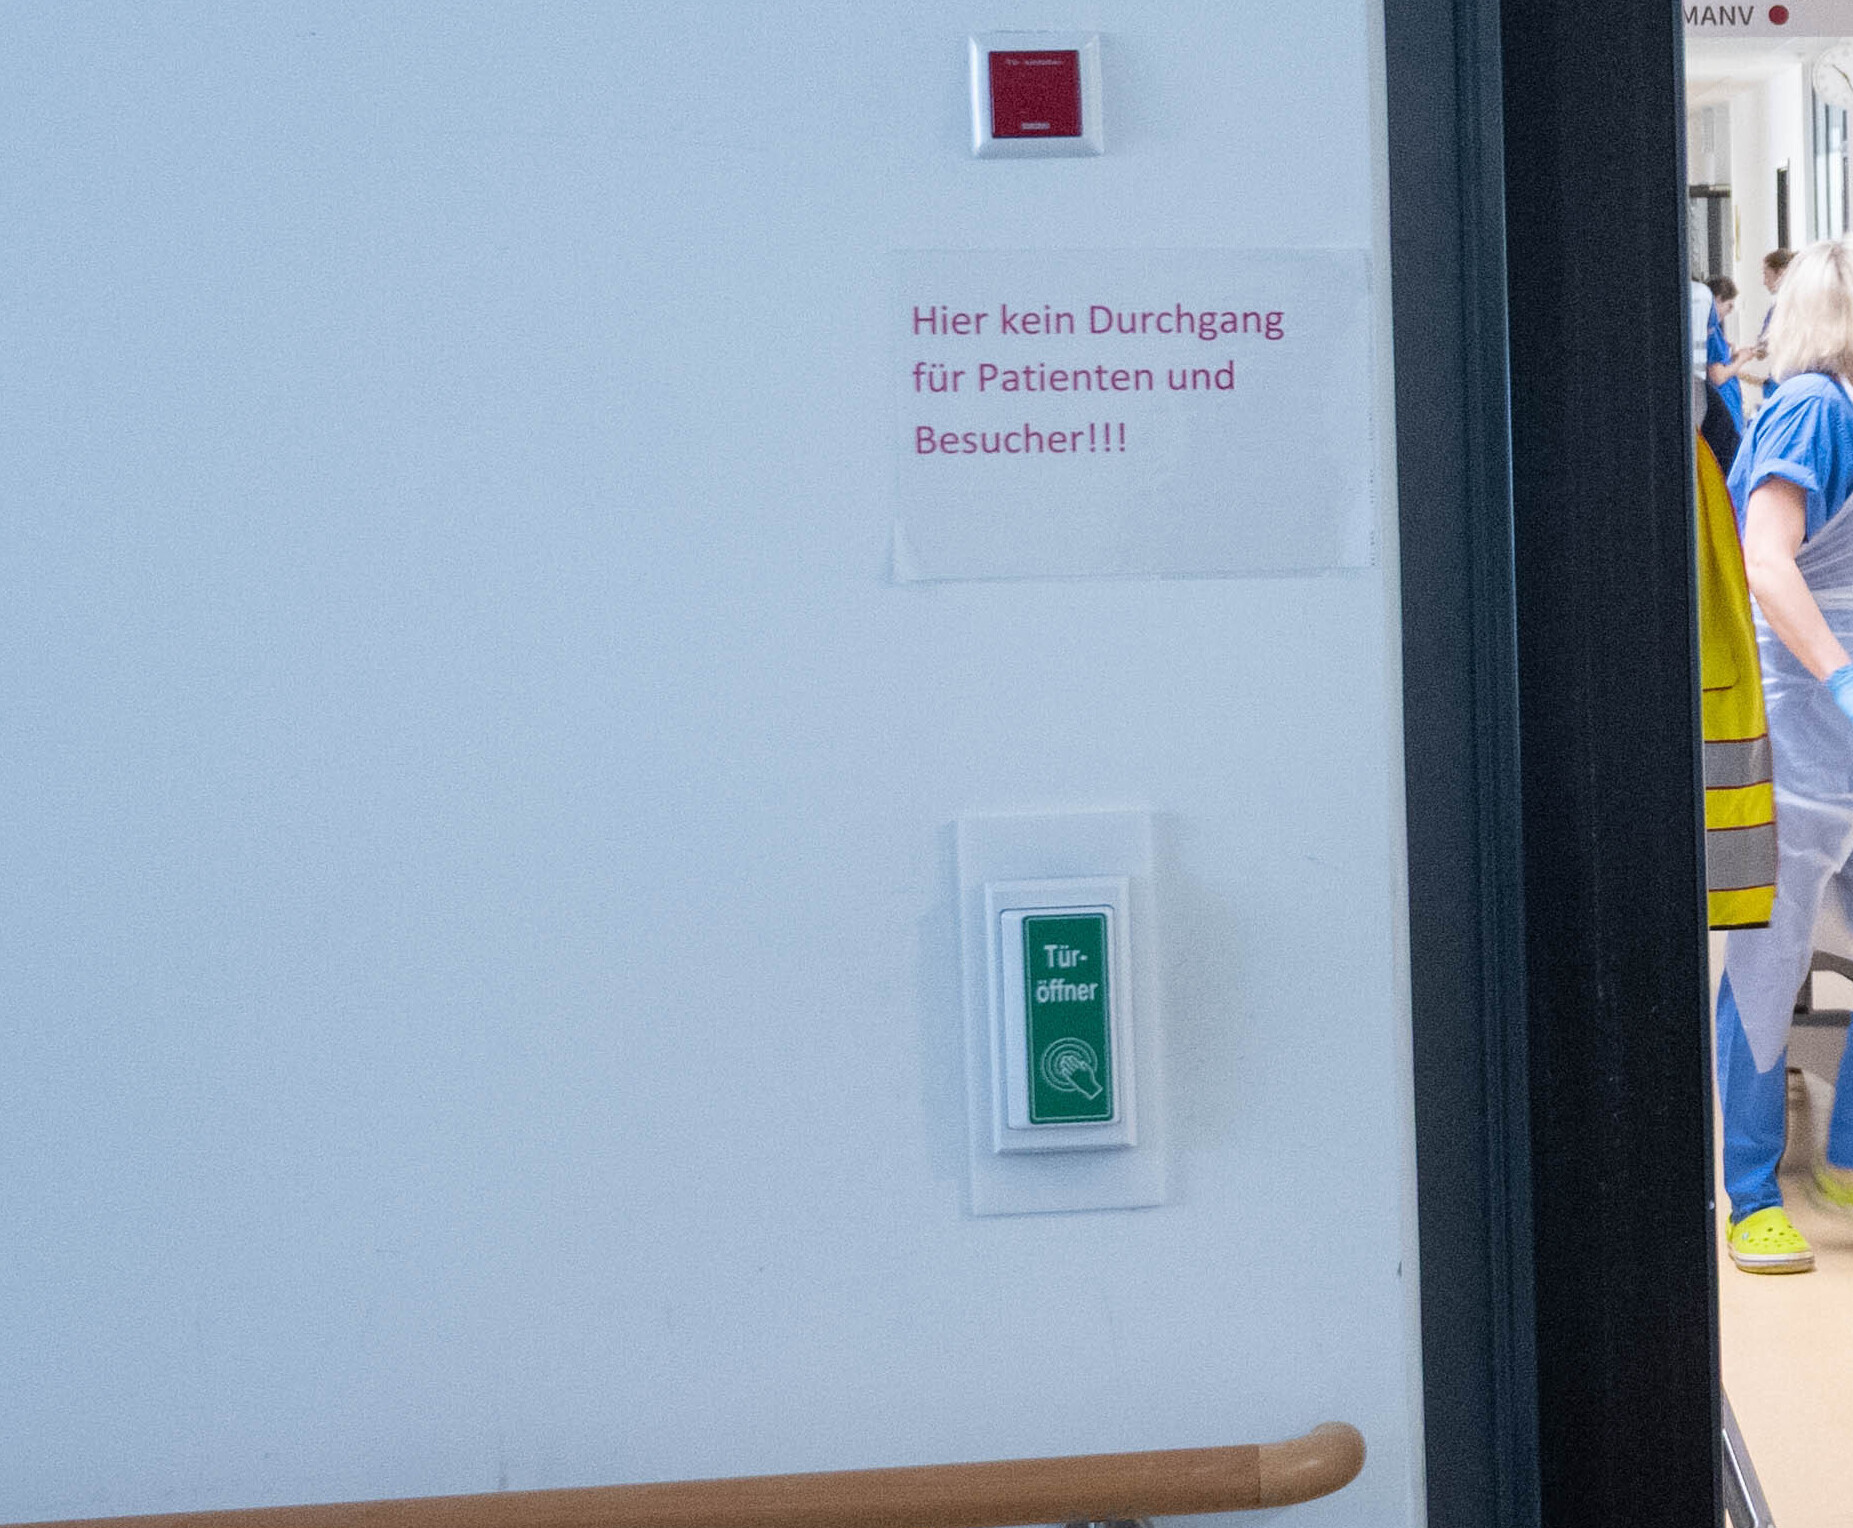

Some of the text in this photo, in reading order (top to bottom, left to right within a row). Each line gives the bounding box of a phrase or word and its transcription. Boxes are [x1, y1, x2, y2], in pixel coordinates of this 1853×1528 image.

[1683, 5, 1754, 26] MANV
[912, 303, 1285, 341] Hier kein Durchgang
[912, 360, 1235, 393] für Patienten und
[915, 422, 1127, 455] Besucher!!!
[1043, 943, 1088, 969] Tür-
[1035, 978, 1099, 1004] öffner
